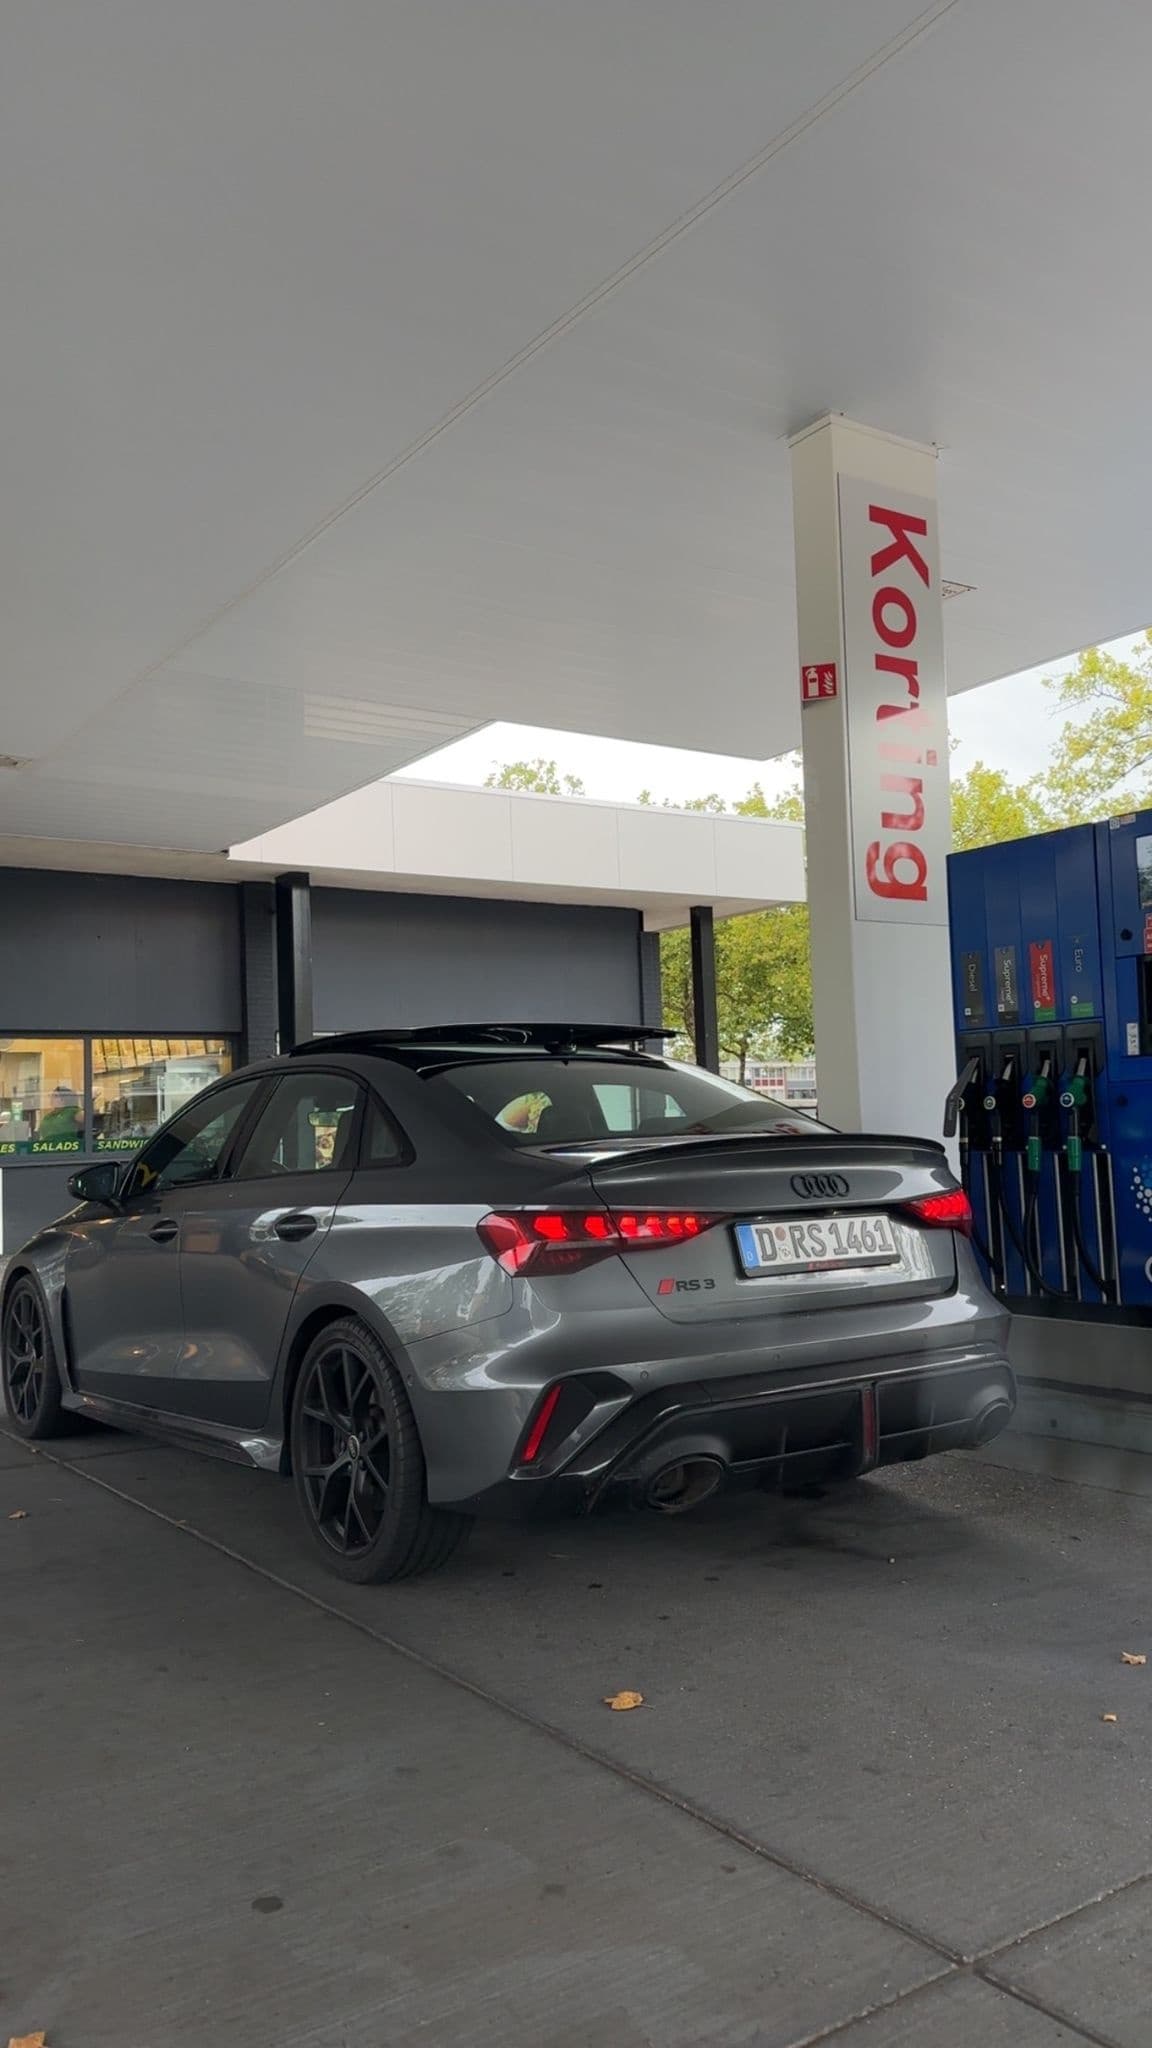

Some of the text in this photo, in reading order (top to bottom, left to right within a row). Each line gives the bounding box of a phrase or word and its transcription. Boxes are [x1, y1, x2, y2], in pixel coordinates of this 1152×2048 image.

[866, 504, 938, 902] Korting
[1074, 948, 1084, 973] Euro
[968, 963, 979, 992] Diesel
[32, 1141, 79, 1152] SALADS
[675, 1278, 715, 1292] RS 3
